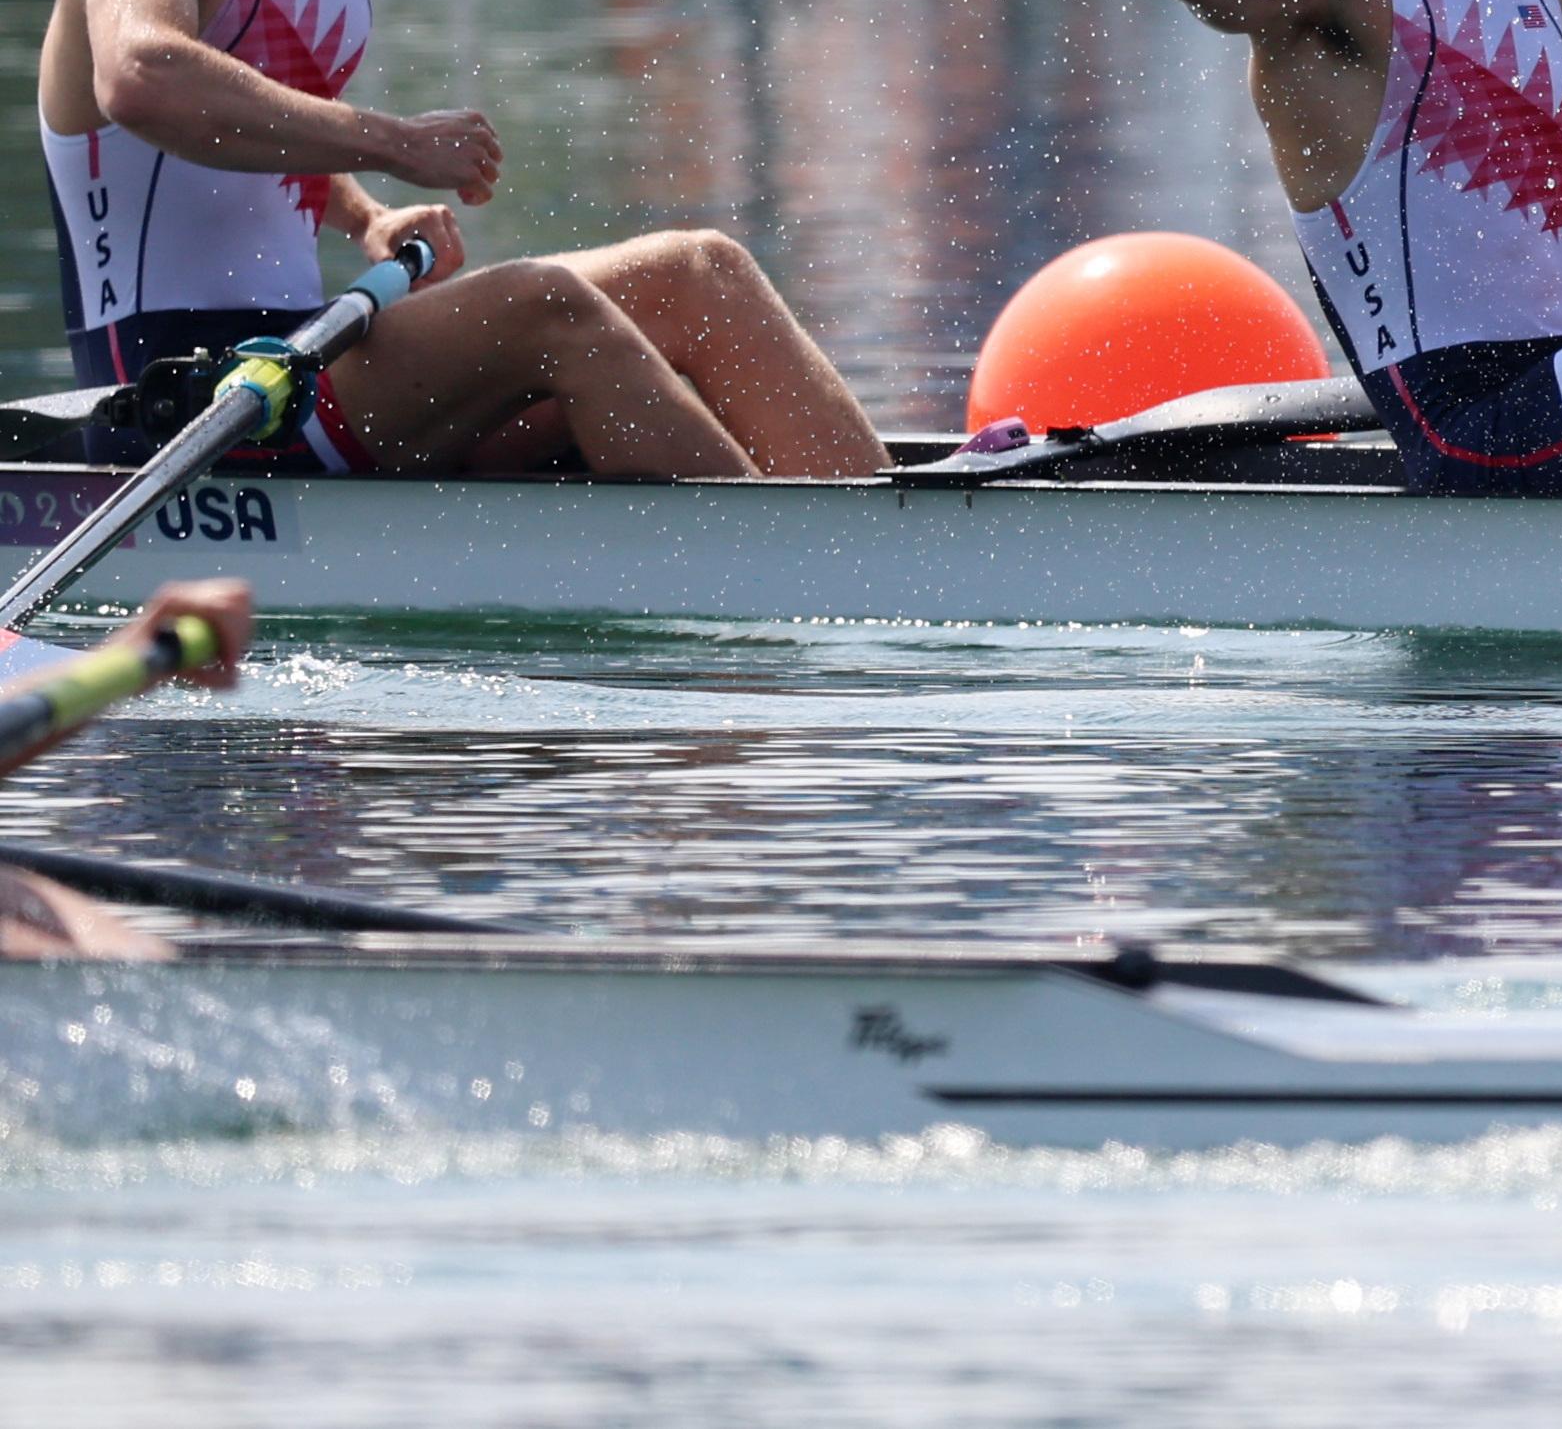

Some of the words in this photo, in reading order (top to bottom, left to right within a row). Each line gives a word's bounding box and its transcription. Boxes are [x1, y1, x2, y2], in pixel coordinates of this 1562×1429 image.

[87, 187, 118, 317] USA
[1345, 241, 1397, 360] USA
[156, 486, 277, 541] USA
